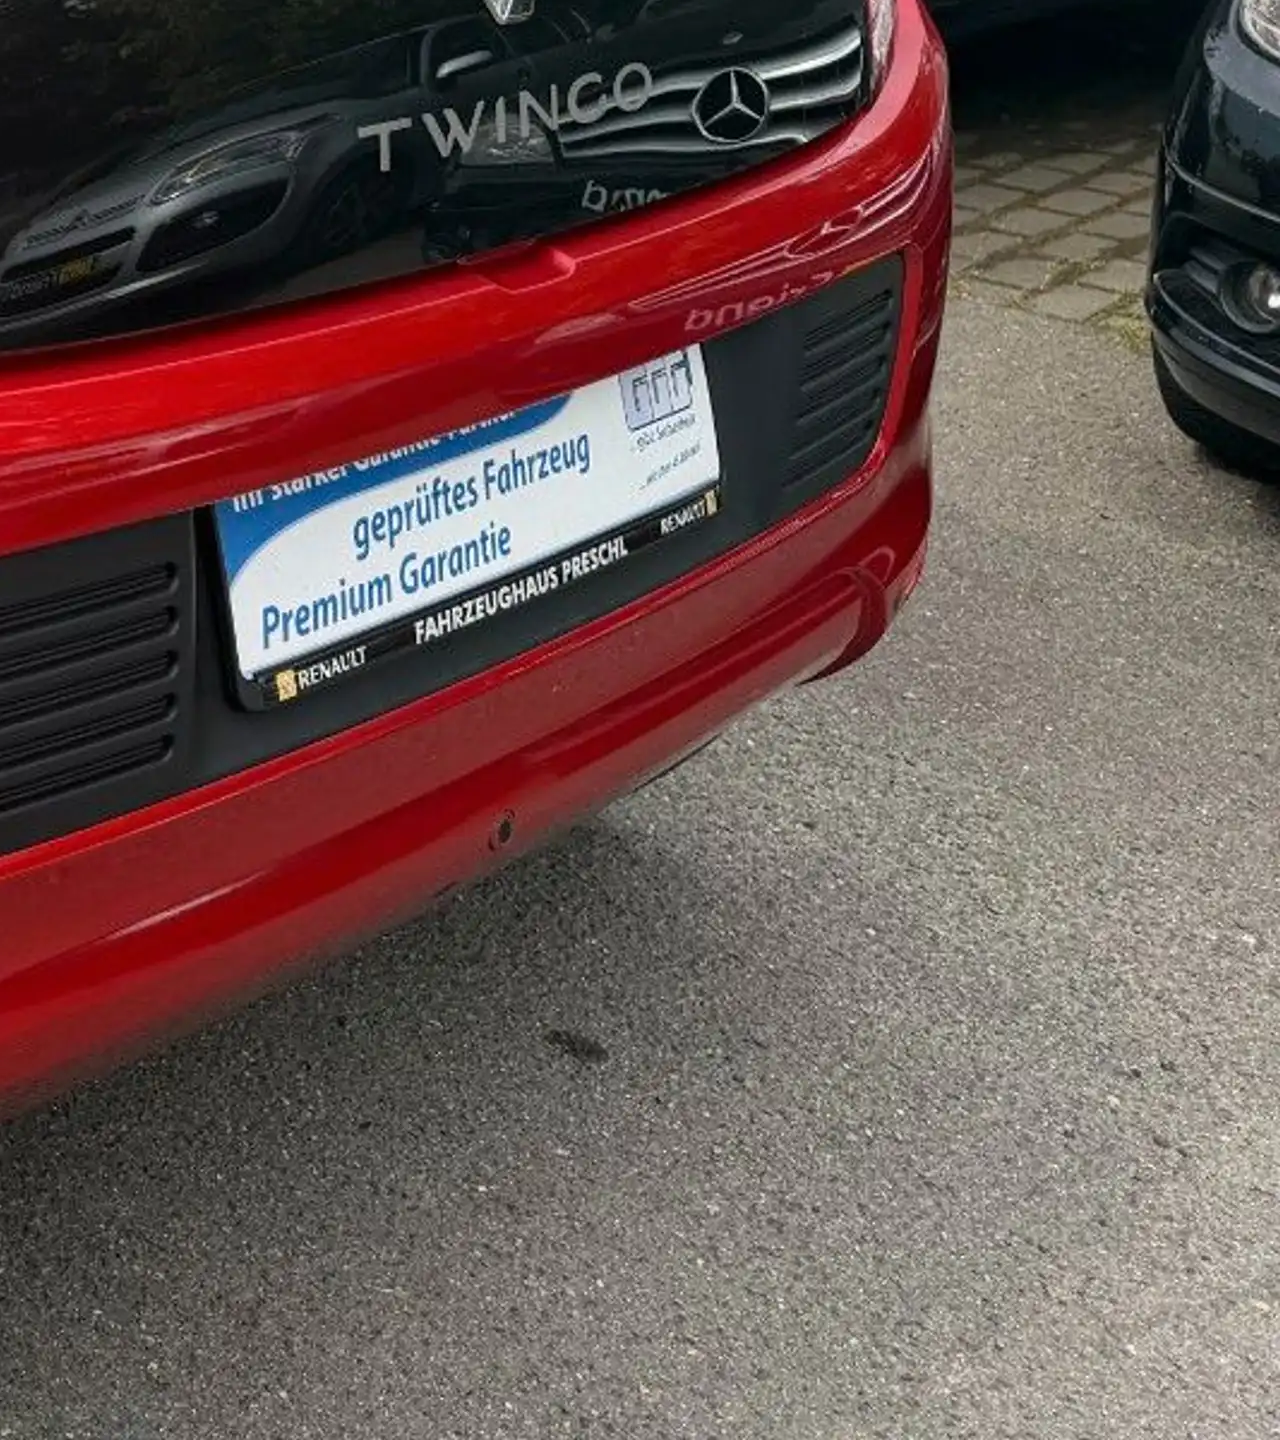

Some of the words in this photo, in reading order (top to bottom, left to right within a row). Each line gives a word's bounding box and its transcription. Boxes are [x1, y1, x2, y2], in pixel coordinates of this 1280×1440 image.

[357, 63, 652, 172] TWINGO
[352, 476, 478, 560] geprüftes
[482, 433, 590, 501] Fahrzeug
[262, 573, 391, 649] Premium
[399, 521, 511, 595] Garantie
[298, 645, 367, 689] RENAULT
[414, 567, 559, 644] FAHRZEUGHAUS
[562, 536, 628, 584] PRESCHL
